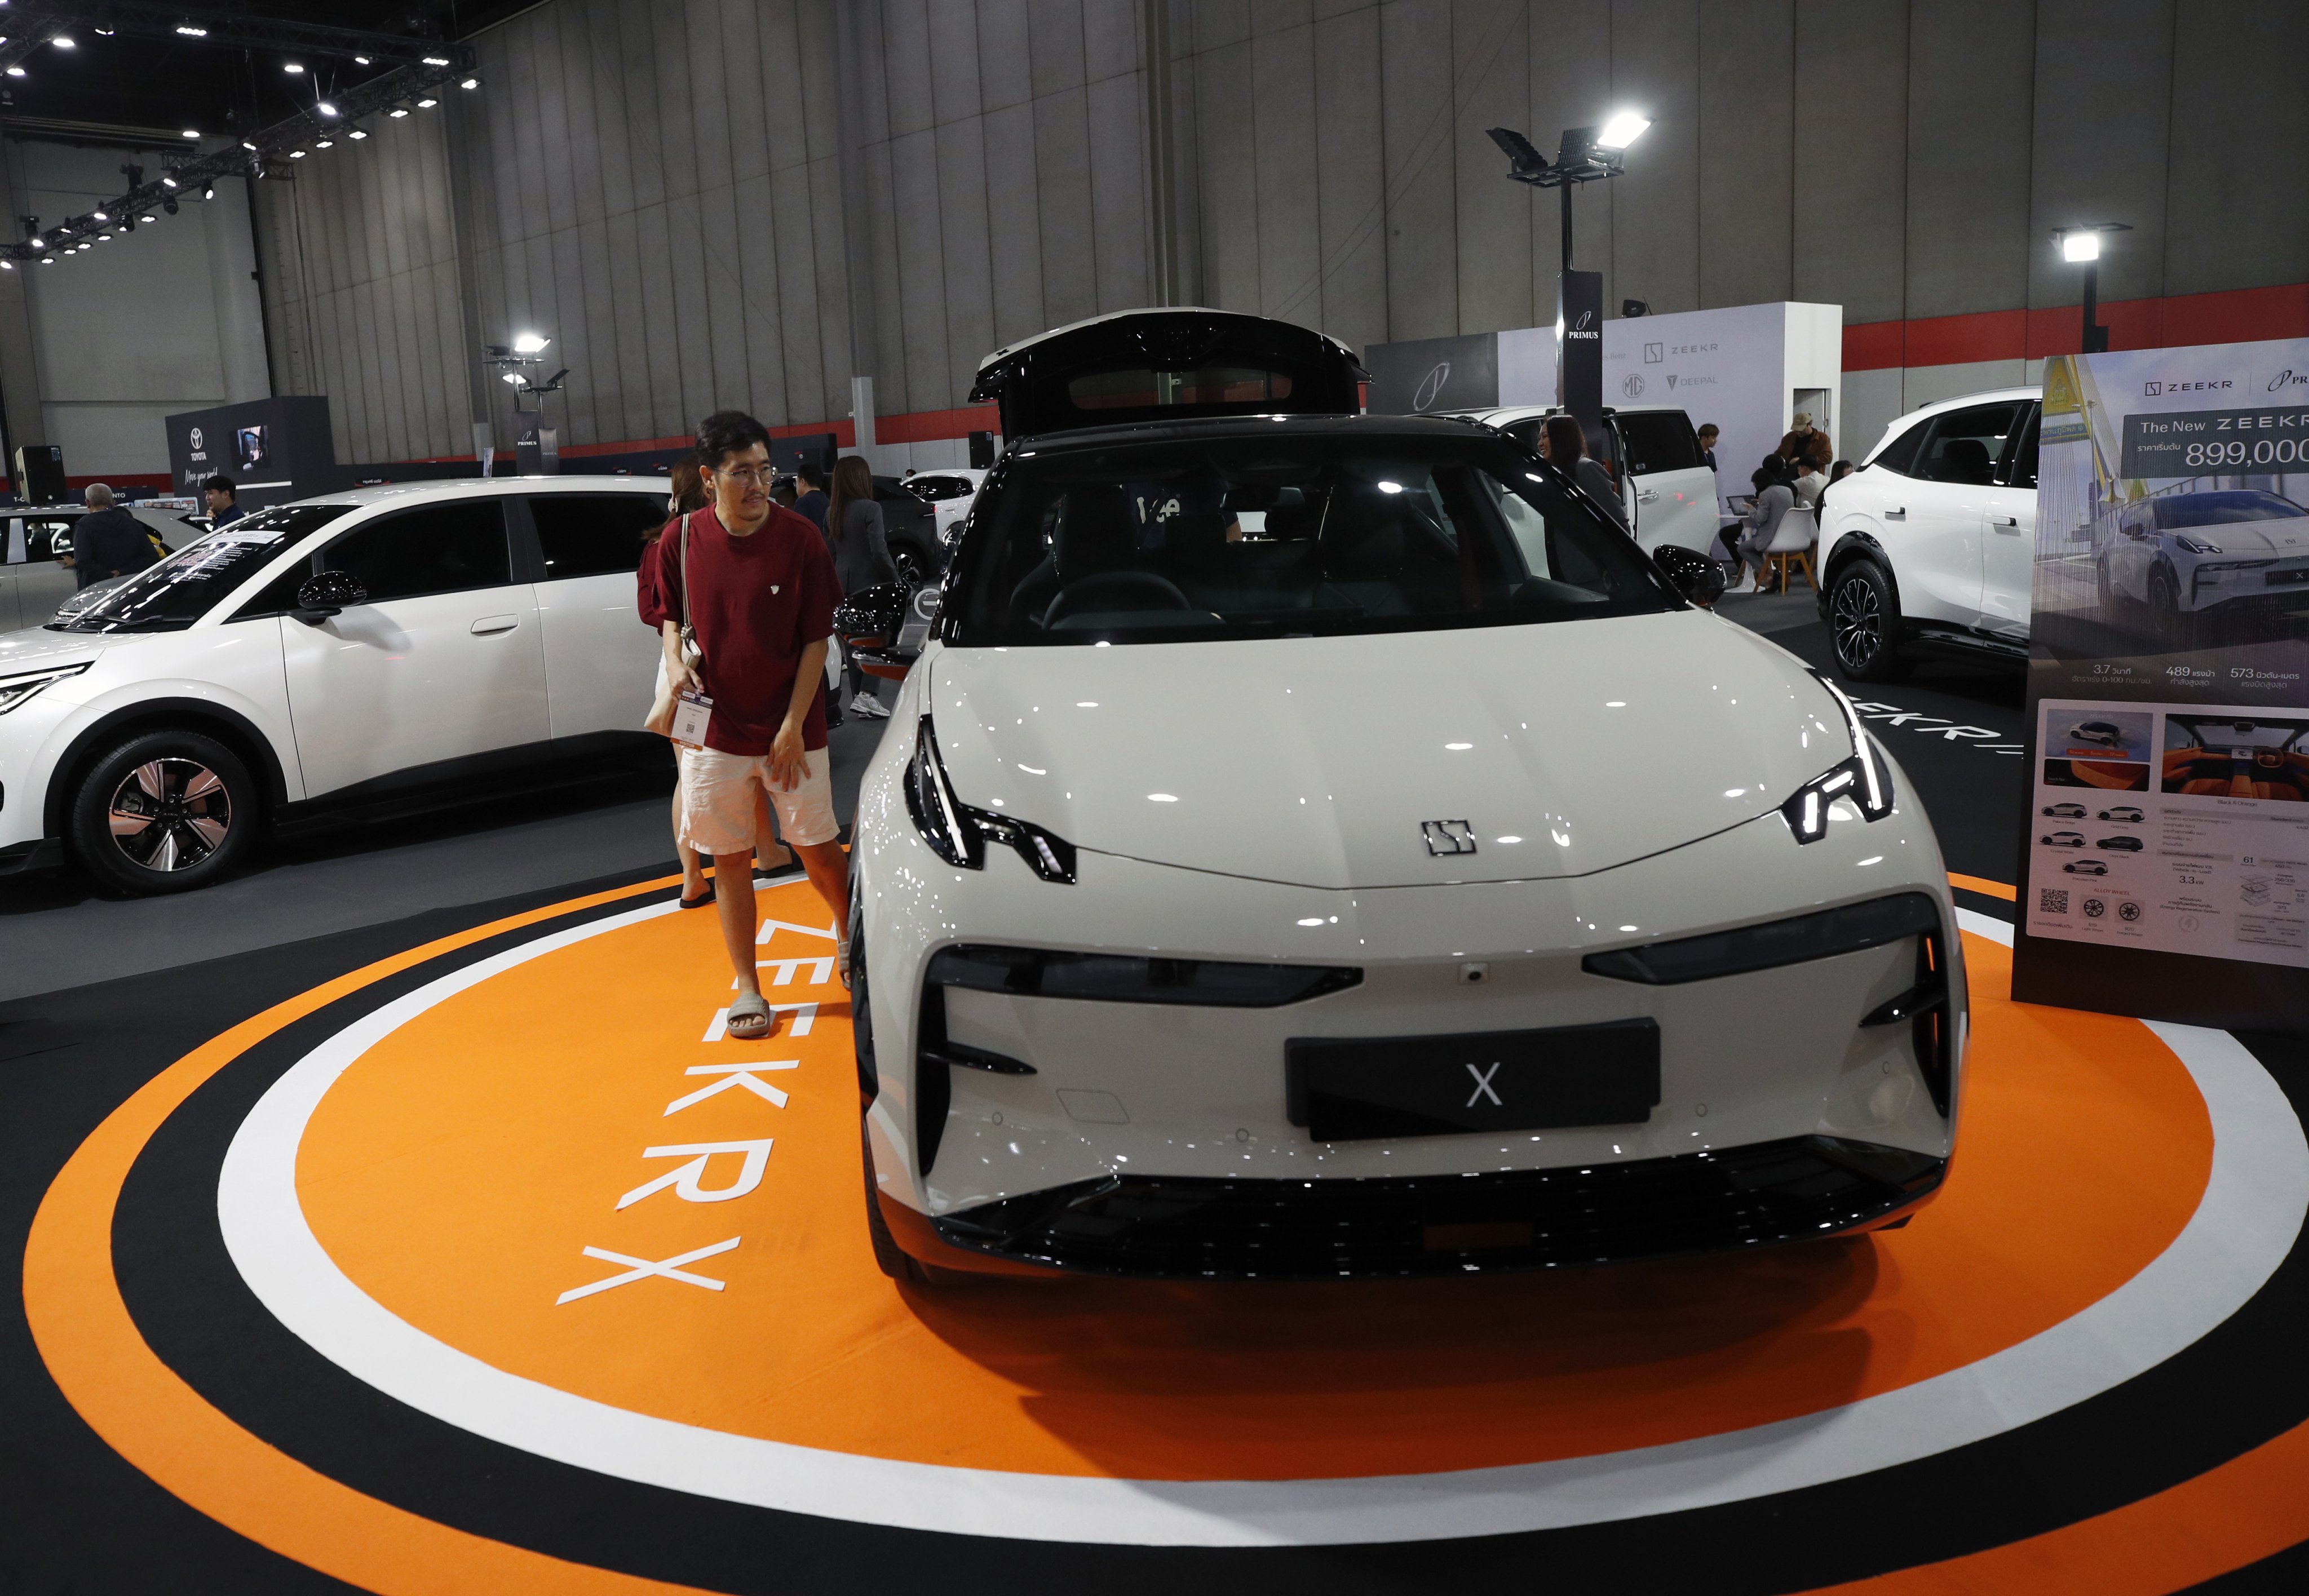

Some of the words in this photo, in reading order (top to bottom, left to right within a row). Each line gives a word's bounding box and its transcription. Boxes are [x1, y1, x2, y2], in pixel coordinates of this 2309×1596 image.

[1671, 344, 1719, 354] ZEEKR
[1624, 375, 1643, 397] MG
[1680, 376, 1719, 386] DEEPAL
[2168, 380, 2233, 392] ZEEKR
[2141, 422, 2169, 433] The
[2173, 420, 2206, 432] New
[2138, 442, 2180, 451] ราคาเริ่มต้น
[191, 452, 207, 461] TOYOTA
[185, 469, 197, 485] Move
[197, 473, 206, 487] your
[2094, 664, 2111, 674] 3.7
[2166, 667, 2190, 676] 489
[2230, 668, 2254, 677] 573
[2179, 875, 2195, 884] 3.3
[1466, 1062, 1503, 1108] X
